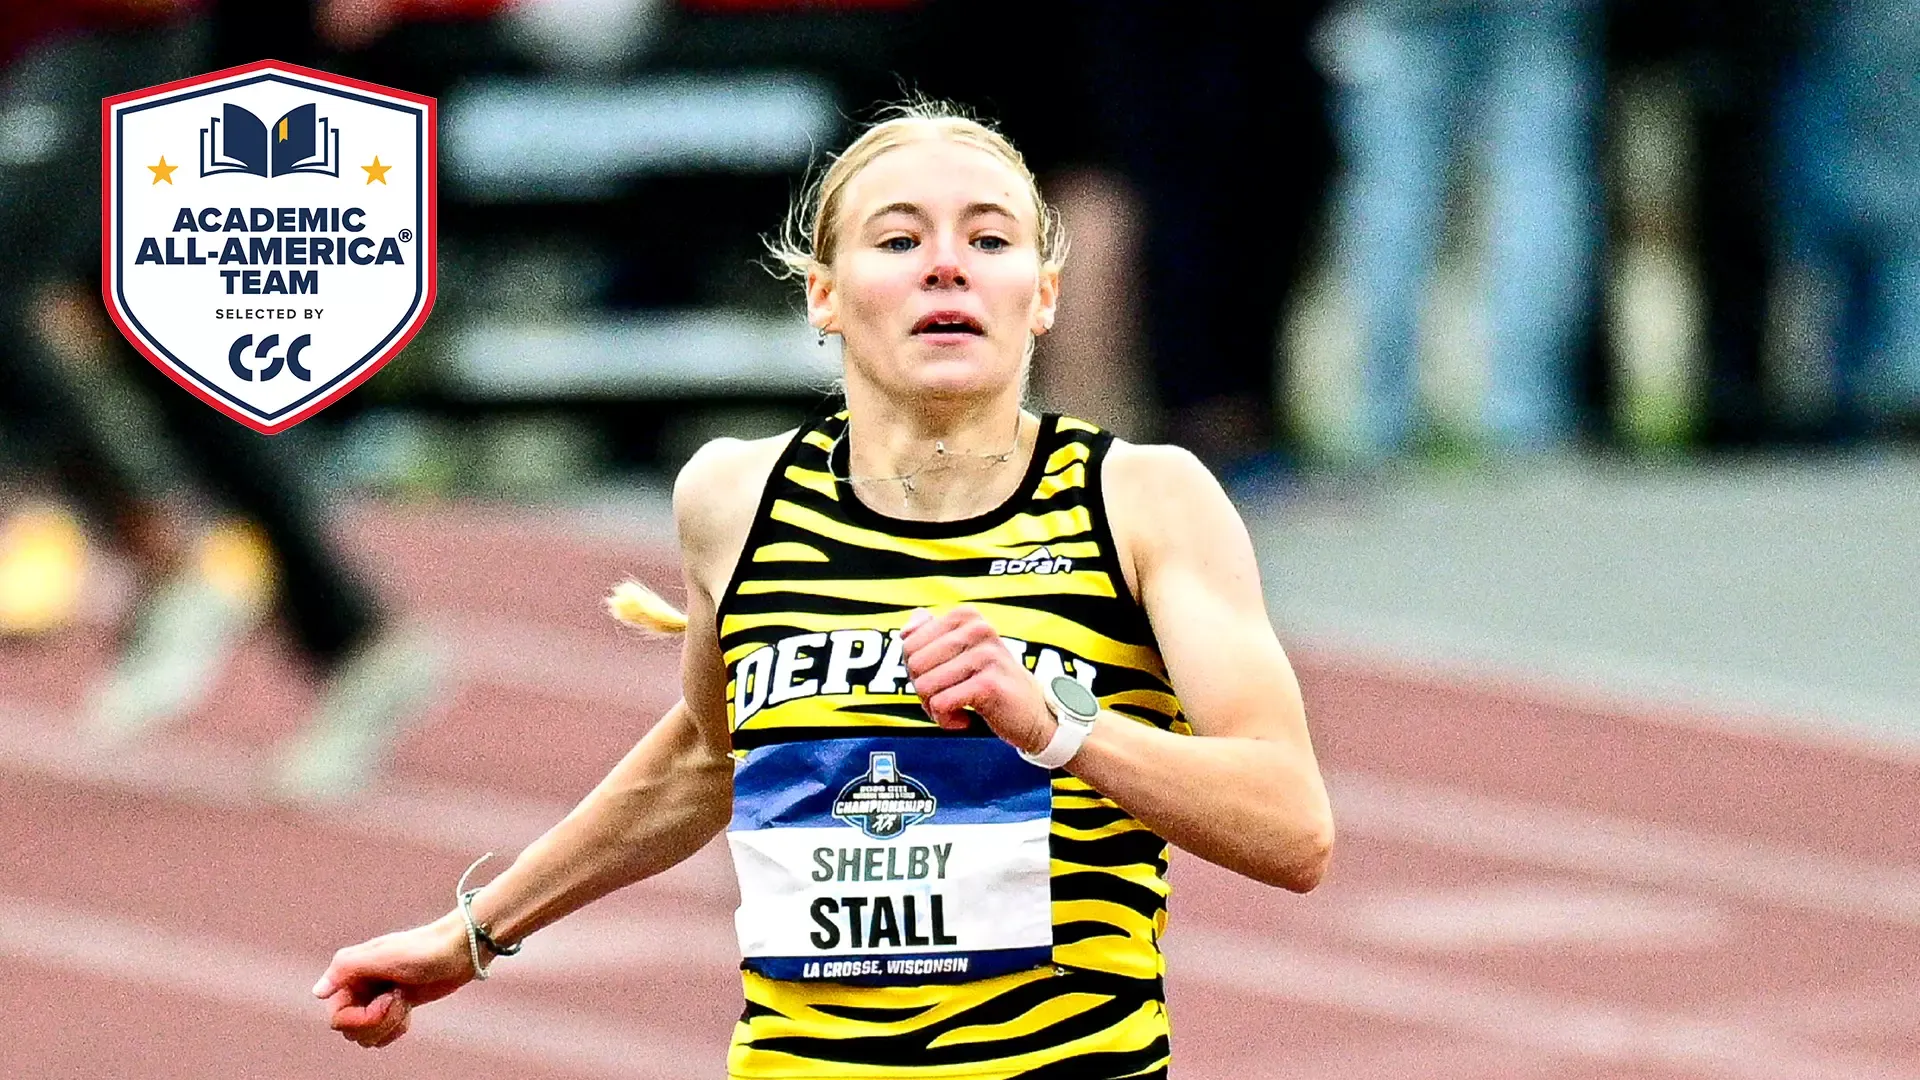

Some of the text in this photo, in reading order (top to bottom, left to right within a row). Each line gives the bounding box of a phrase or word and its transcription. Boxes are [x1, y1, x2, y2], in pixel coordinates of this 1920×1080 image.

[835, 799, 933, 815] CHAMPIONSHIPS
[811, 843, 953, 882] SHELBY
[809, 894, 957, 950] STALL
[803, 957, 969, 978] LA CROSSE, WISCONSIN
